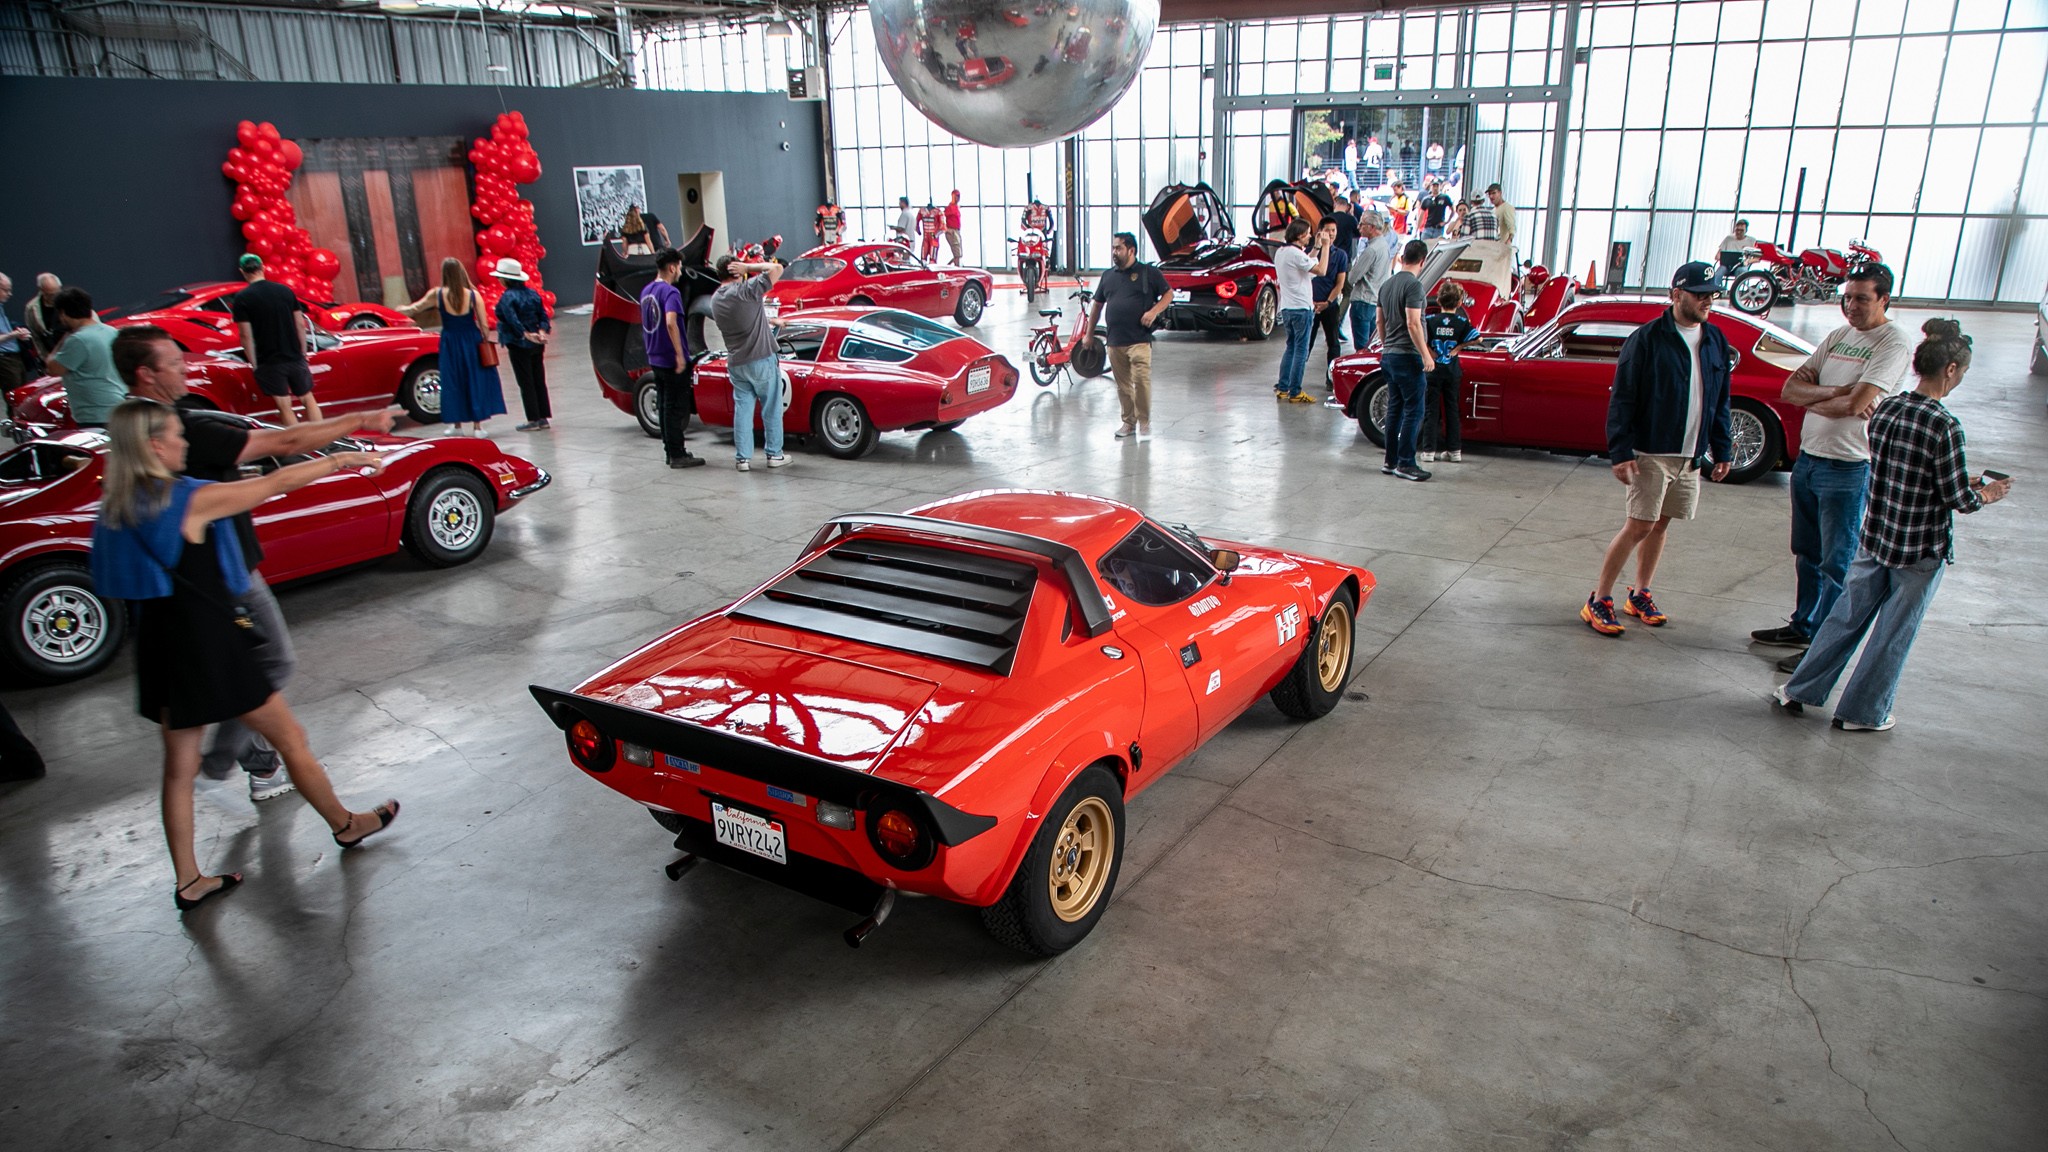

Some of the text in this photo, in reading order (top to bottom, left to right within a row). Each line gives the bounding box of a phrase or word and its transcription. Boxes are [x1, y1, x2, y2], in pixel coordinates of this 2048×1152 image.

[1436, 327, 1455, 337] GIBBS
[1275, 603, 1300, 647] HF
[667, 756, 689, 773] LANCIA
[726, 807, 772, 829] California
[717, 818, 783, 859] 9VRY242
